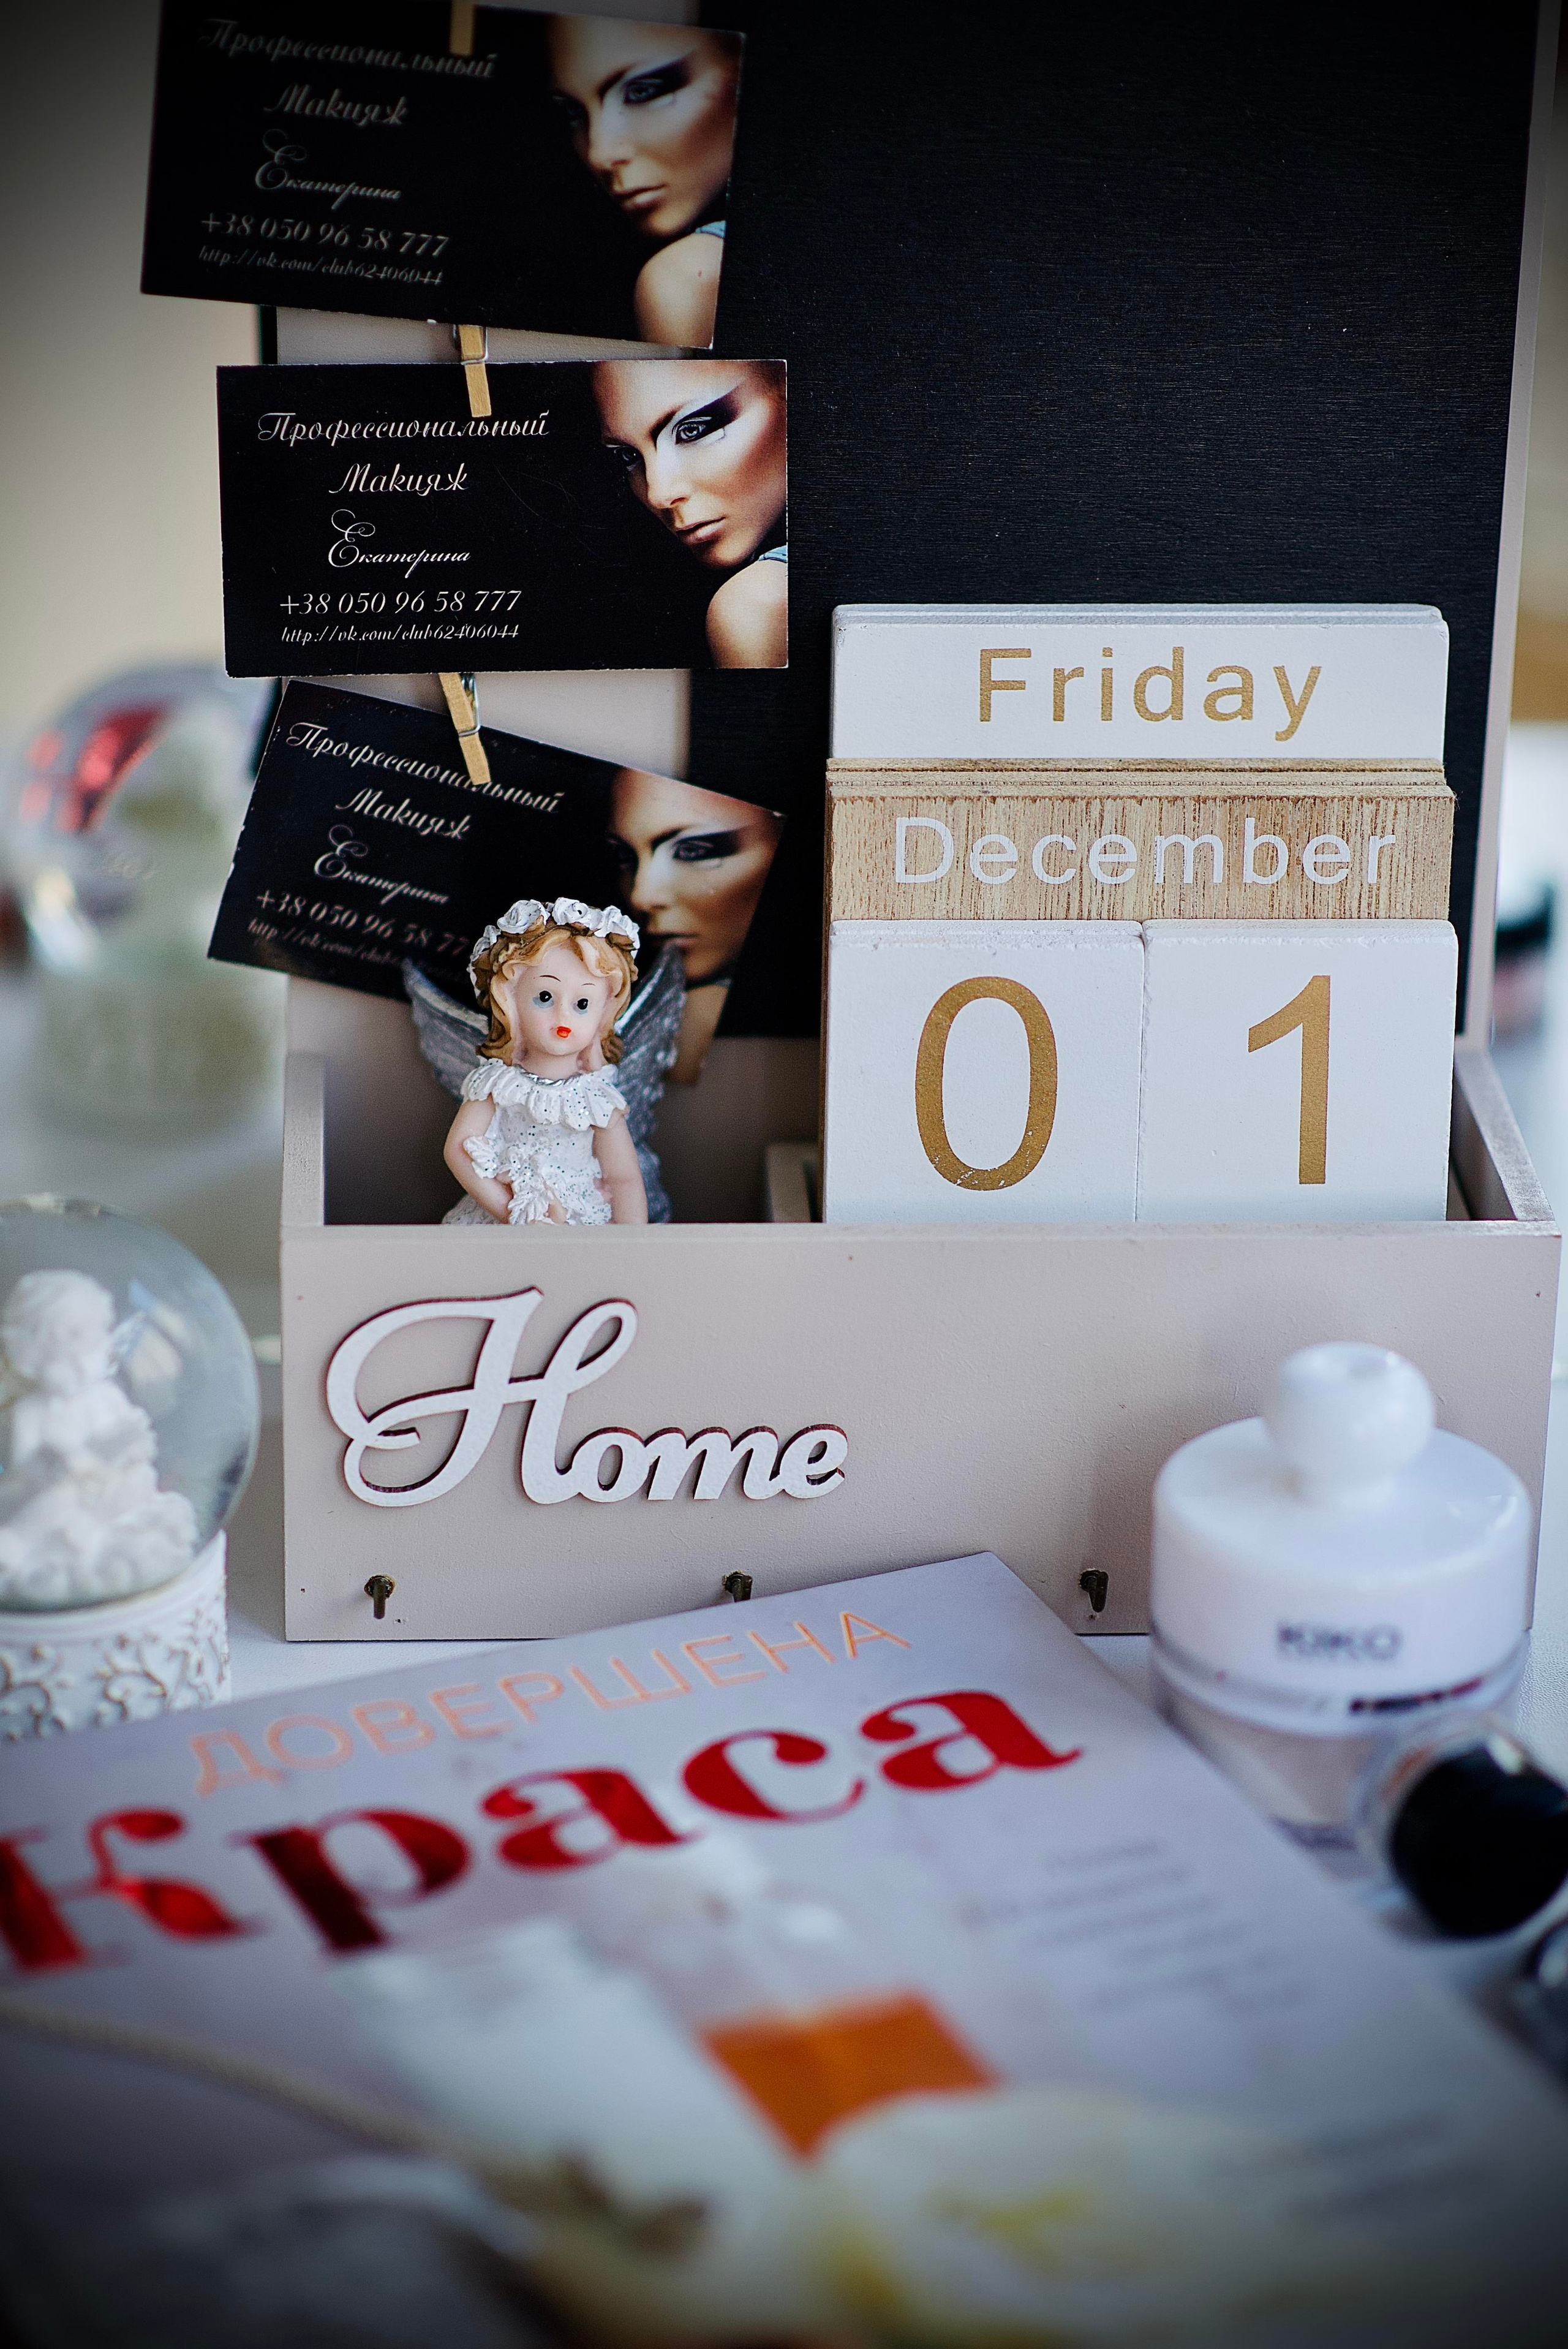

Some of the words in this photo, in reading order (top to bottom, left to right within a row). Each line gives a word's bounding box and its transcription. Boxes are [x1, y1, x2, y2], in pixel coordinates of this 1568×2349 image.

[198, 18, 498, 79] Профессиональный
[263, 83, 407, 126] Макияж
[255, 128, 402, 211] Екатерина
[201, 212, 253, 236] +38
[260, 217, 309, 241] 050
[319, 223, 350, 246] 96
[358, 227, 391, 250] 58
[399, 232, 450, 257] 777
[257, 409, 550, 447] Профессиональный
[328, 463, 468, 496] Макияж
[328, 509, 471, 578] Екатерина
[279, 593, 330, 616] +38
[339, 592, 386, 613] 050
[396, 591, 425, 613] 96
[434, 591, 466, 612] 58
[474, 590, 522, 612] 777
[979, 646, 1322, 743] Friday
[335, 788, 472, 841] Макияж
[314, 824, 449, 906] Екатерина
[894, 816, 1398, 886] December
[256, 889, 306, 917] +38
[309, 902, 358, 929] 050
[361, 914, 395, 941] 96
[402, 922, 433, 947] 58
[325, 1285, 849, 1507] Home
[1276, 1617, 1404, 1662] KIKO
[190, 1610, 913, 1798] ДОВЕРШЕНА
